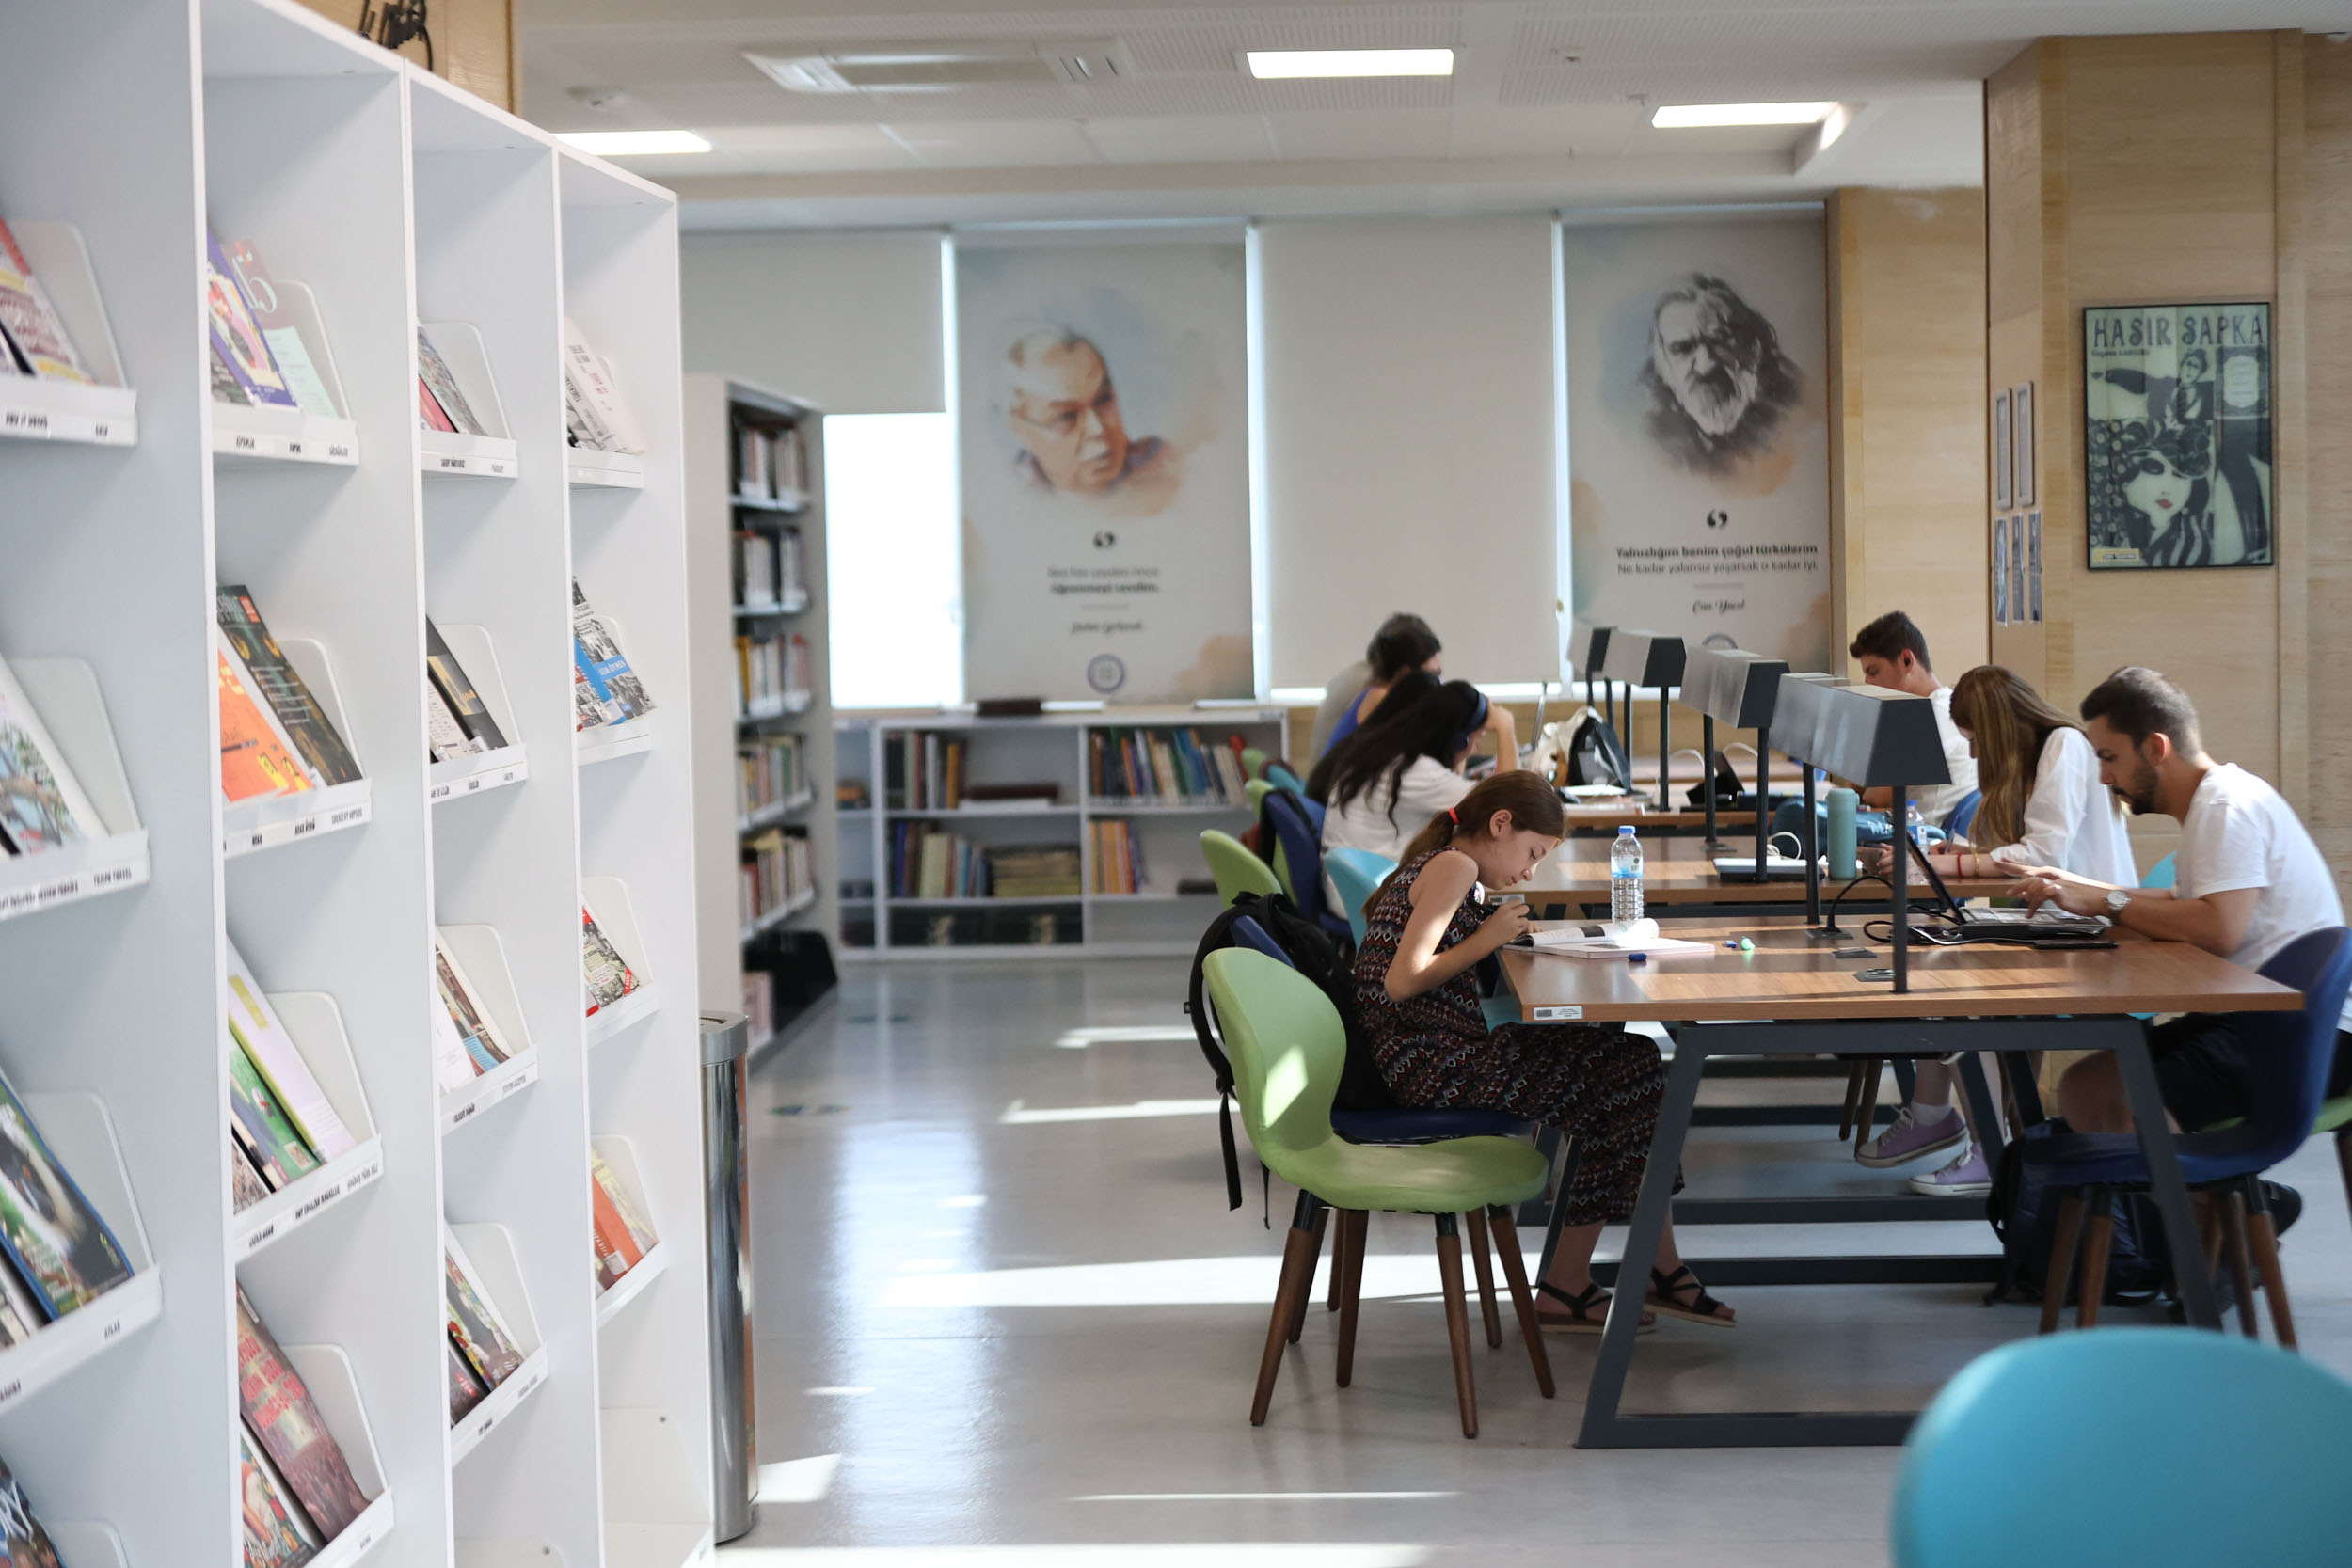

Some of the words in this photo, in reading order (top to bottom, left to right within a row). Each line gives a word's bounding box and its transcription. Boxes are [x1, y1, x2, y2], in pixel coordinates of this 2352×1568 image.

[2093, 317, 2172, 347] HASIR
[1681, 546, 1719, 557] benim
[1722, 545, 1754, 559] çoğul
[1756, 543, 1818, 556] türkülerim
[1617, 563, 1633, 574] Ne
[1635, 562, 1665, 574] kadar
[1771, 562, 1801, 572] kadar
